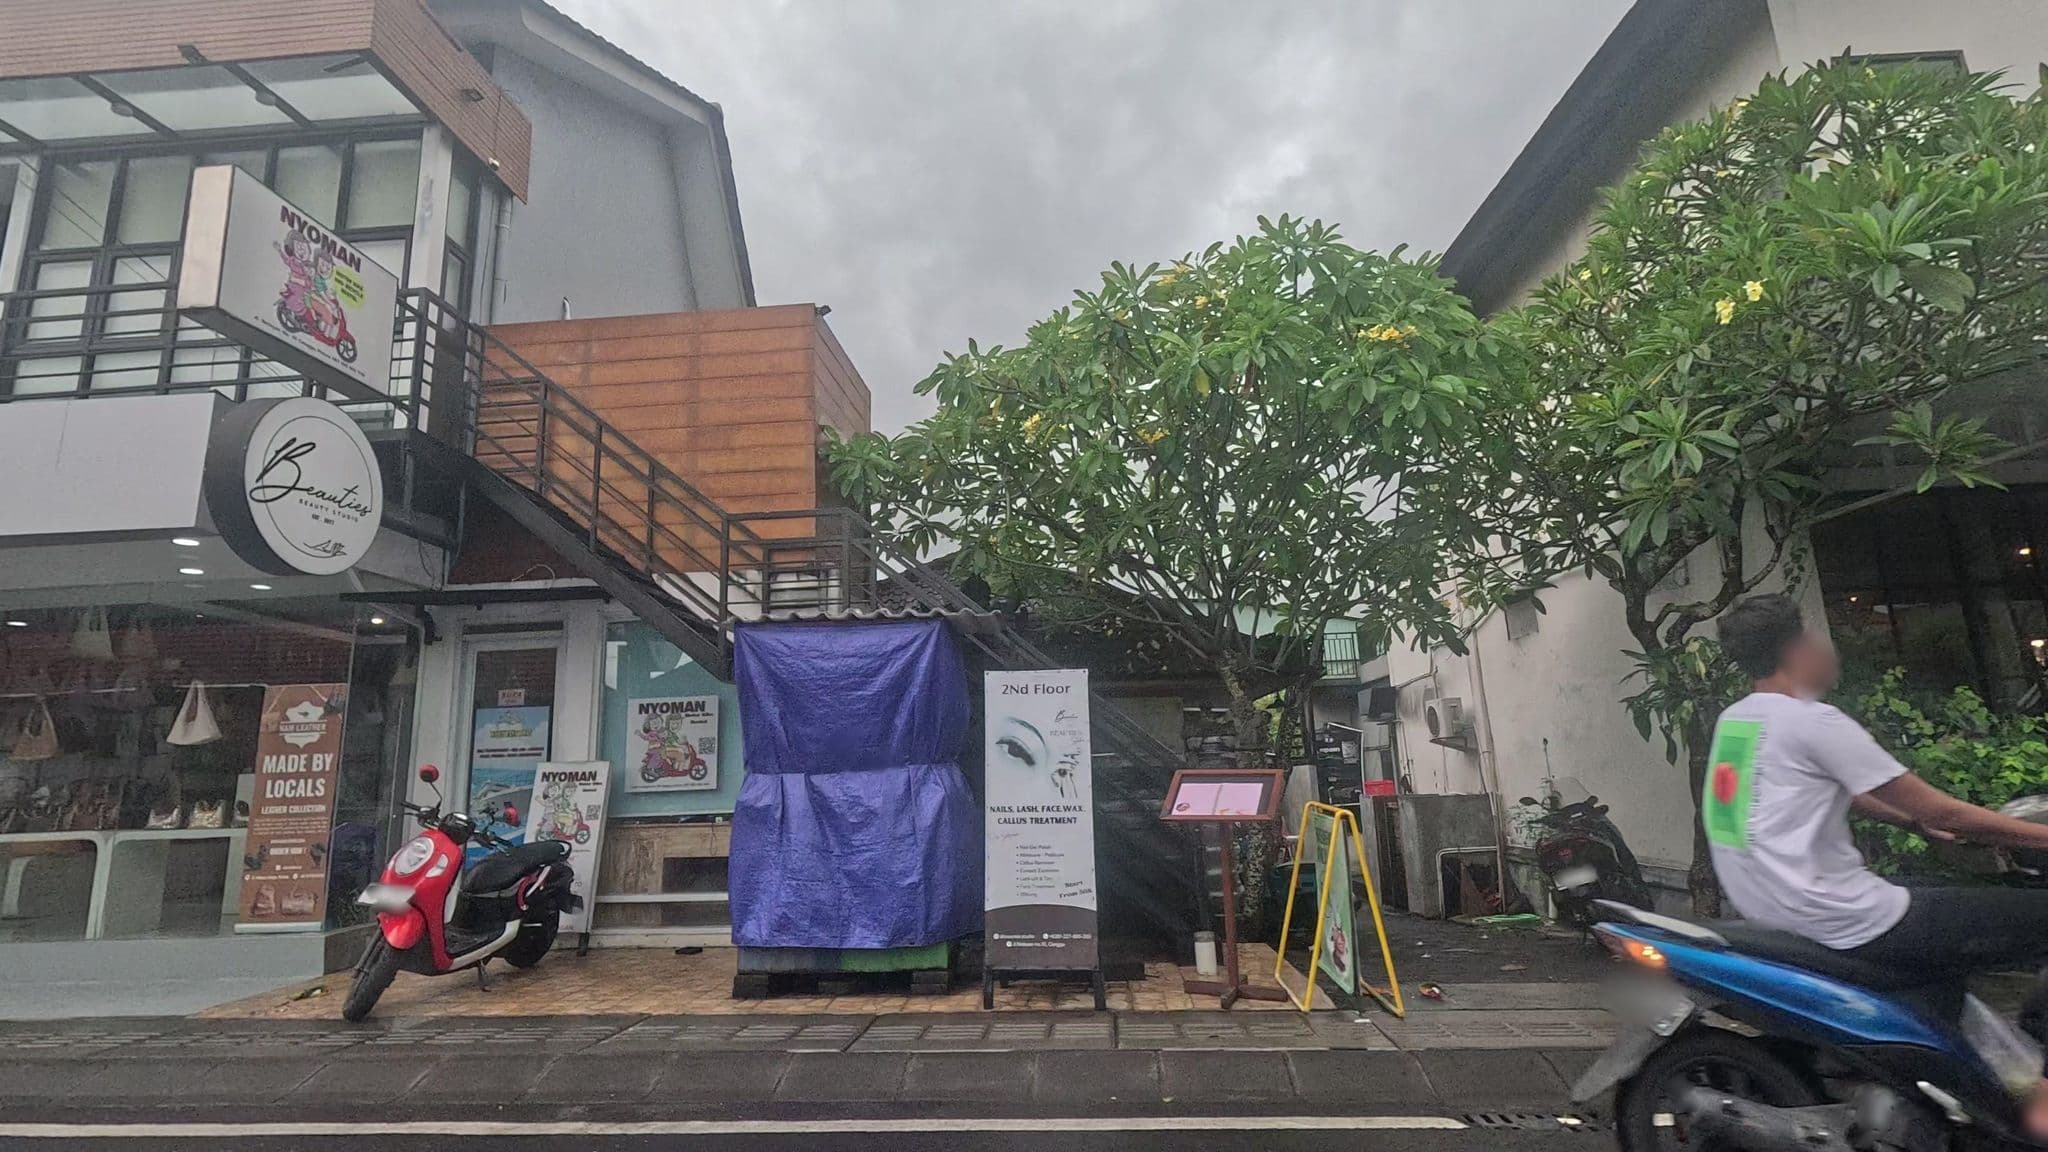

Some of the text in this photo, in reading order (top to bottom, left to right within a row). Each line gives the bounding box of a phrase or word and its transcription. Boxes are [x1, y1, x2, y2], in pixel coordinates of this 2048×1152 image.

[280, 205, 361, 273] NYOMAN
[249, 437, 372, 517] Beauties
[299, 498, 329, 512] BEAUTY
[1002, 683, 1072, 695] 2Nd Floor
[638, 700, 707, 715] NYOMAN
[262, 752, 334, 775] MADE BY
[540, 770, 597, 783] NYOMAN
[265, 777, 327, 799] LOCALS
[1029, 816, 1078, 825] TREATMENT
